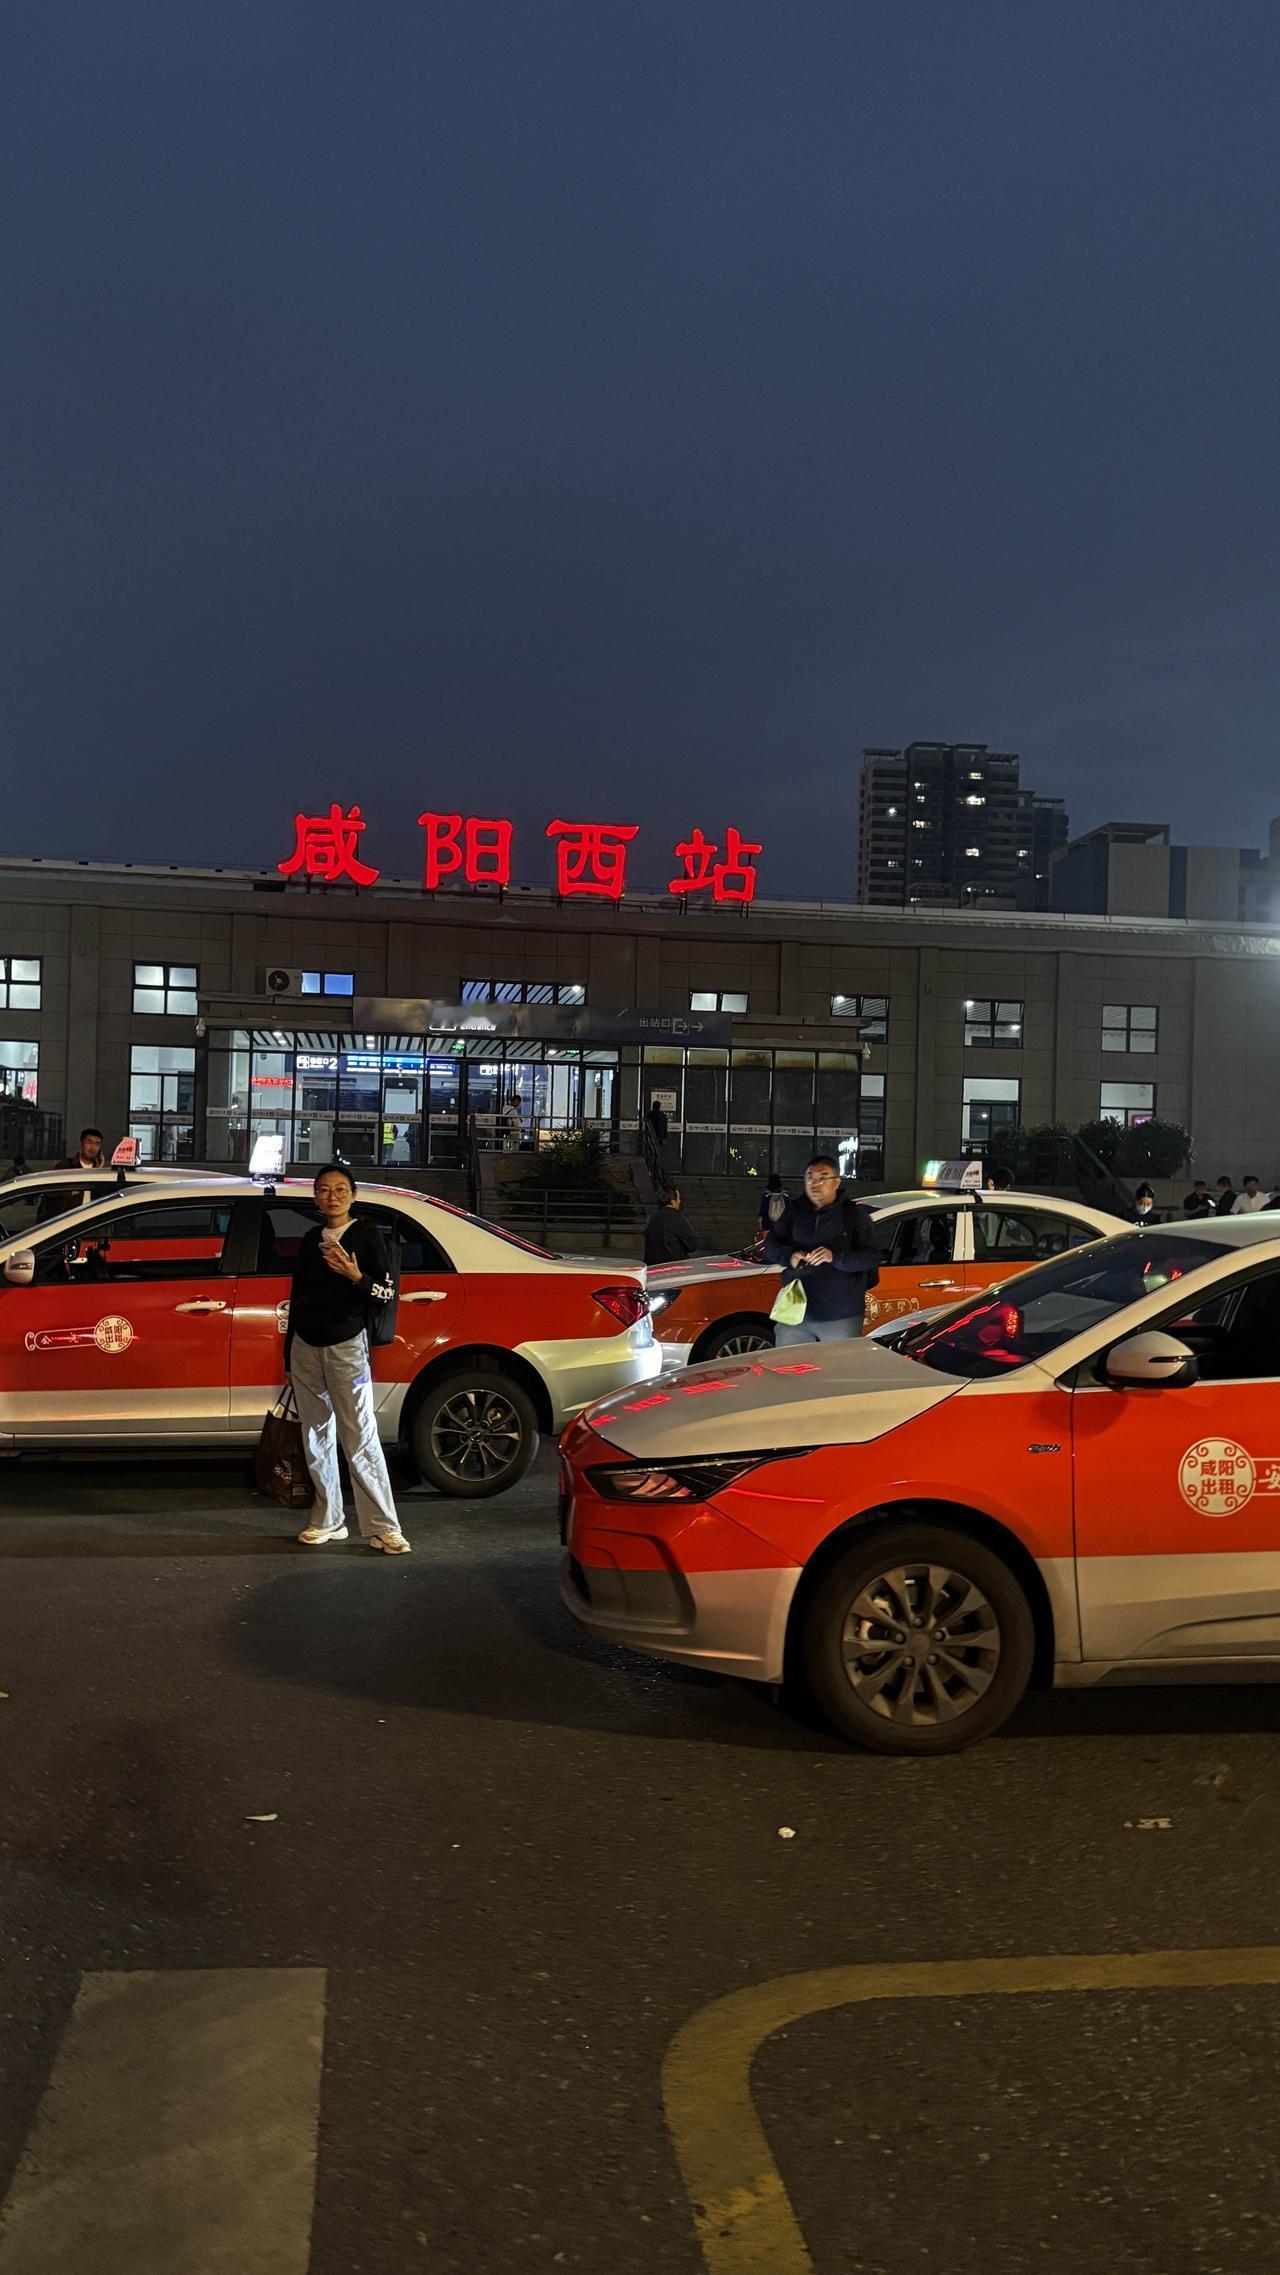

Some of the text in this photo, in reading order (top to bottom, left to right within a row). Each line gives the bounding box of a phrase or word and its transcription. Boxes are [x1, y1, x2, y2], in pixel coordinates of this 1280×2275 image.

[278, 804, 762, 901] 咸阳西站
[640, 1018, 671, 1028] 出站口
[1200, 1459, 1234, 1476] 咸阳
[1200, 1478, 1235, 1495] 出租
